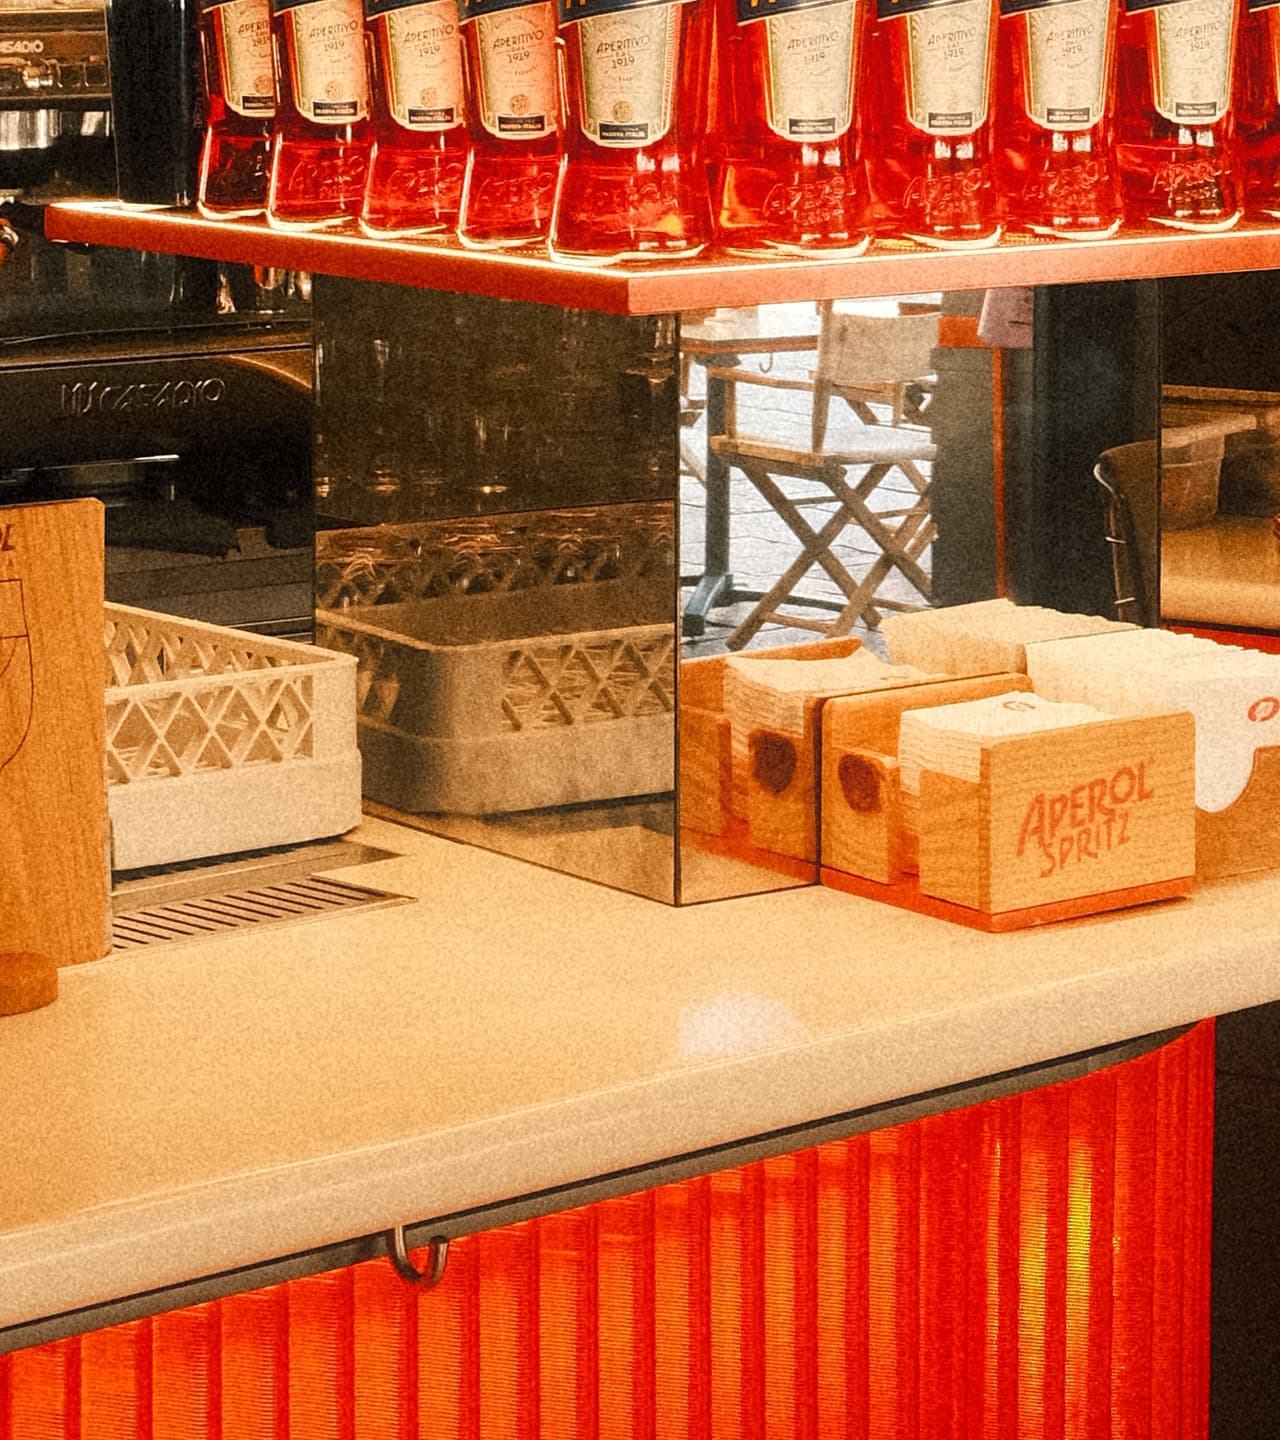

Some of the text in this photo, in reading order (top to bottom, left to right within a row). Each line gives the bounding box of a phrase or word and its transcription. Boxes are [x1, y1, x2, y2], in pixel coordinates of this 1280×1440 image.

[492, 28, 545, 51] APERITIVO
[507, 49, 531, 63] 1919
[612, 55, 636, 69] 1919
[1017, 760, 1154, 857] APEROL
[1040, 811, 1130, 878] SPRITZ
